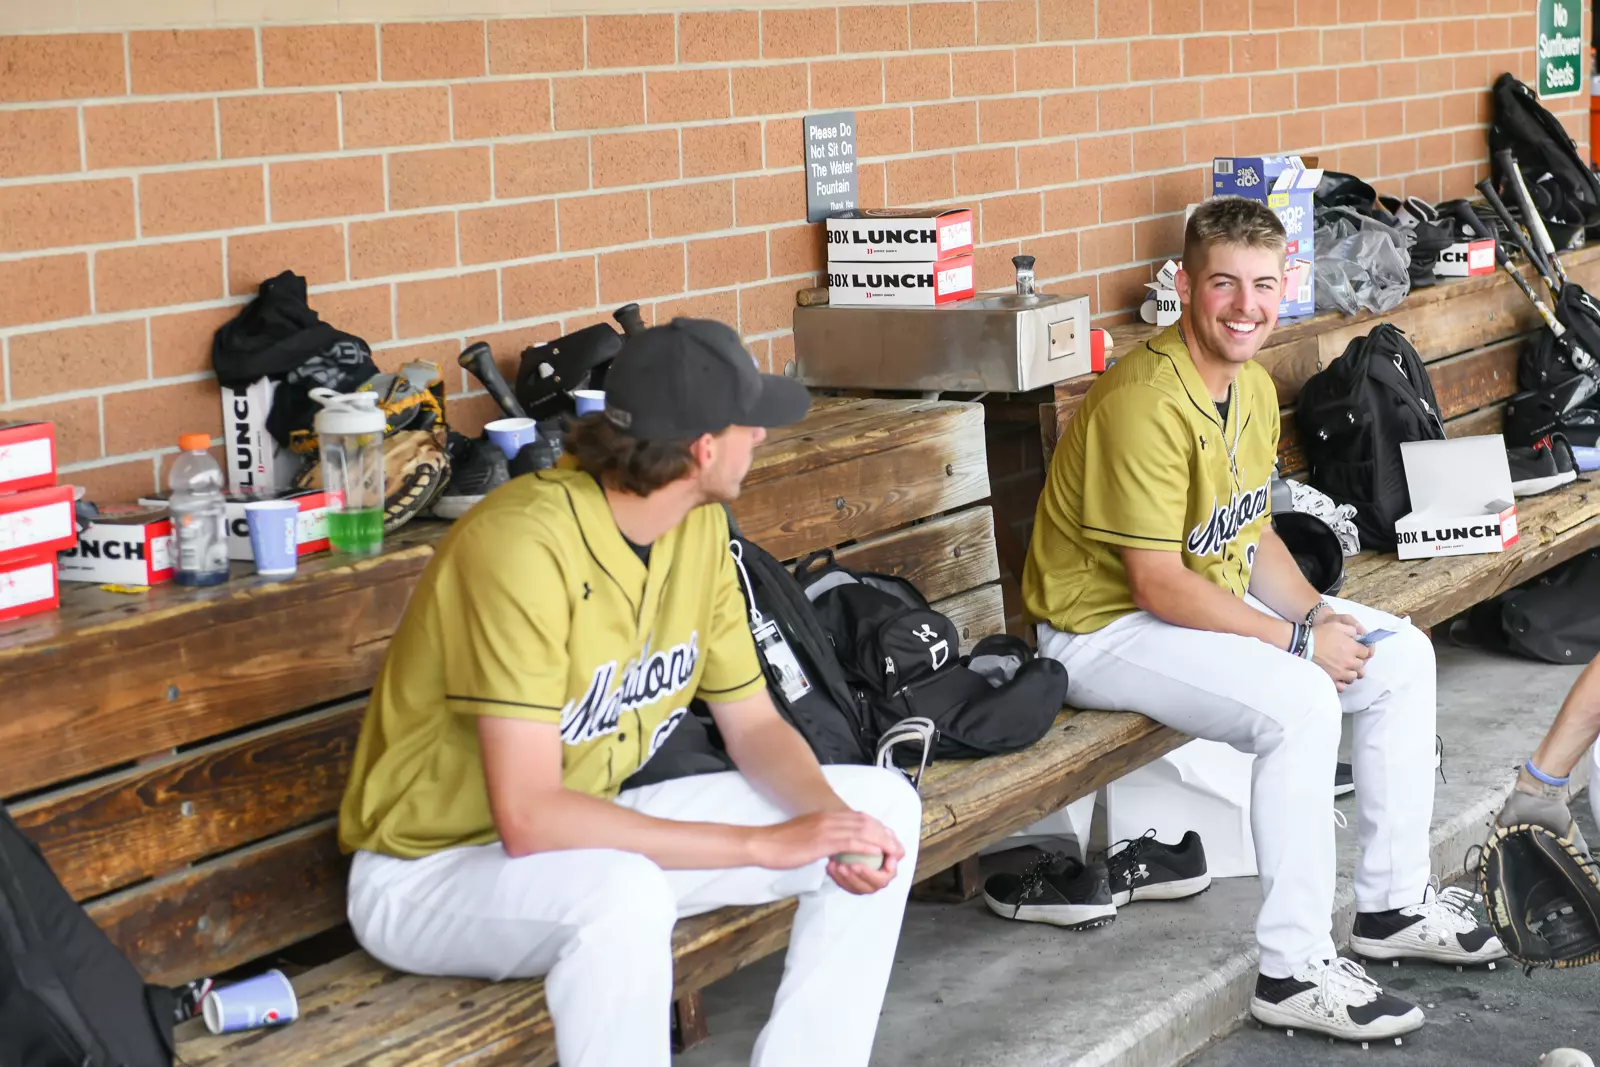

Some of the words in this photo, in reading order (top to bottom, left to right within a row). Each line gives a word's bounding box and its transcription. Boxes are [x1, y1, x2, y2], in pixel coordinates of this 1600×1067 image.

[1553, 2, 1568, 27] No
[1539, 32, 1581, 59] Sunflower
[1546, 61, 1574, 88] Seeds
[809, 125, 837, 141] Please
[840, 122, 852, 137] Do
[810, 144, 826, 159] Not
[828, 142, 839, 157] Sit
[841, 140, 852, 155] On
[811, 163, 827, 178] The
[829, 161, 854, 176] Water
[816, 178, 850, 196] Fountain
[830, 201, 844, 211] Thank
[845, 199, 854, 208] You
[828, 230, 849, 244] BOX
[852, 229, 937, 244] LUNCH
[828, 274, 849, 288] BOX
[852, 274, 934, 288] LUNCH
[1157, 300, 1176, 312] BOX
[1396, 531, 1418, 545] BOX
[1421, 524, 1501, 543] LUNCH
